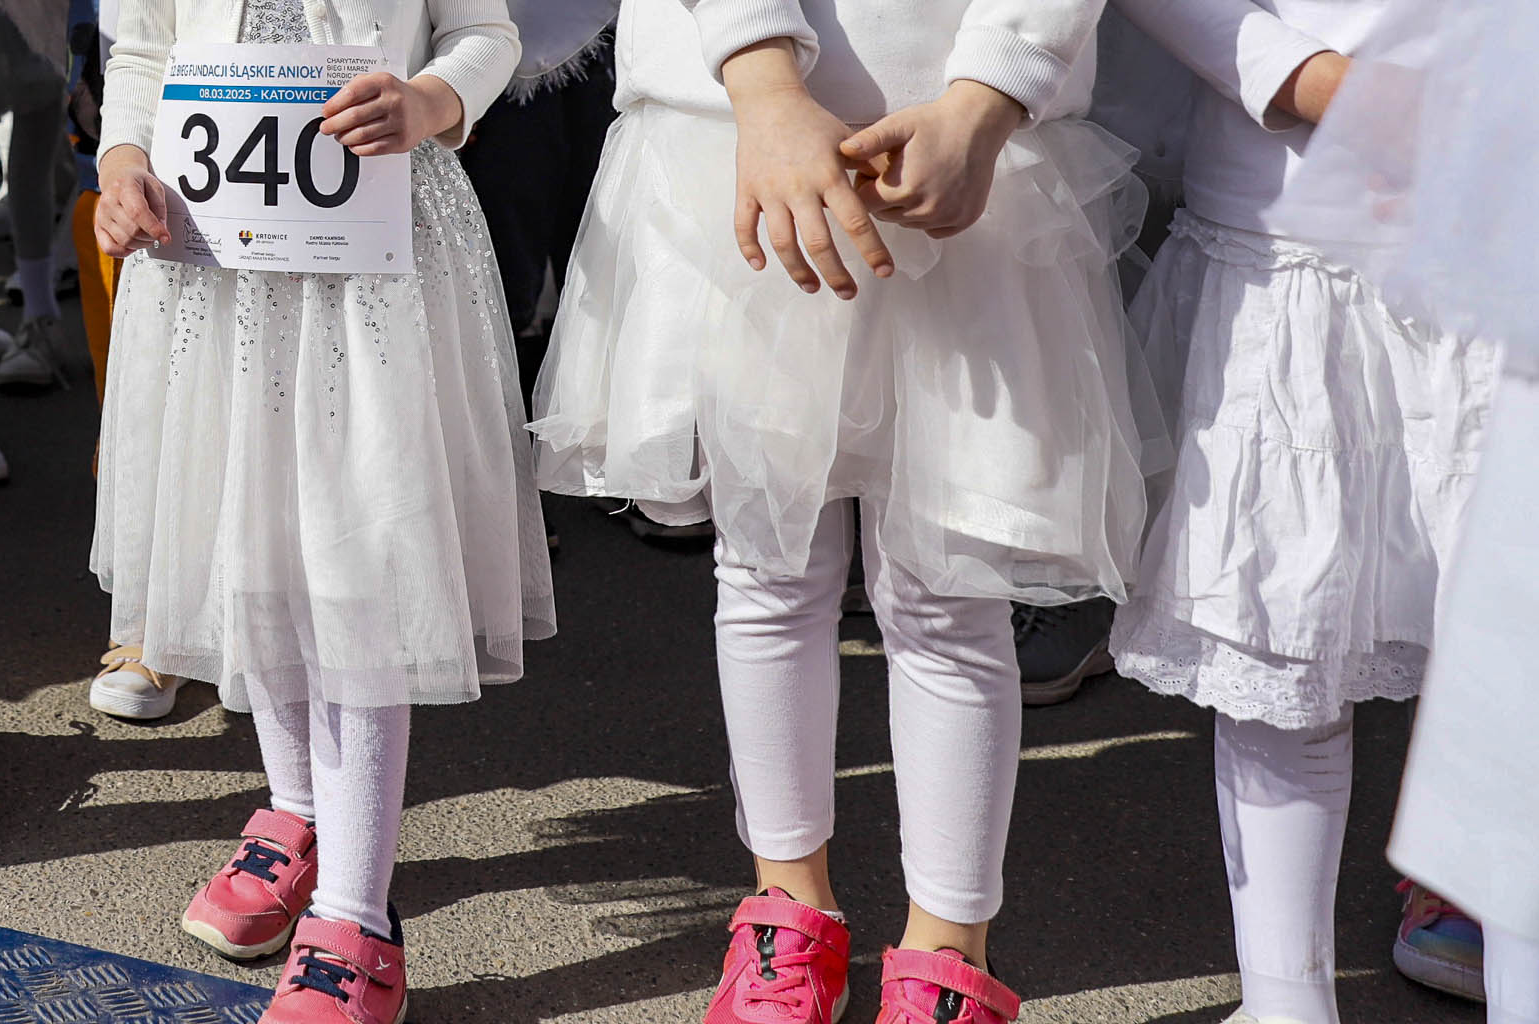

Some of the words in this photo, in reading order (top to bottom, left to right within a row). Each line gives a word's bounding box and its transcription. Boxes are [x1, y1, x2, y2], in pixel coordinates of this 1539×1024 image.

[326, 57, 377, 65] CHARYTATYWNY
[176, 64, 189, 77] BIEG
[189, 63, 228, 77] FUNDACJI
[230, 62, 276, 81] ŚLĄSKIE
[277, 65, 324, 79] ANIOŁY
[199, 89, 251, 100] 08.03.2025
[261, 90, 328, 101] KATOWICE
[178, 112, 360, 209] 340
